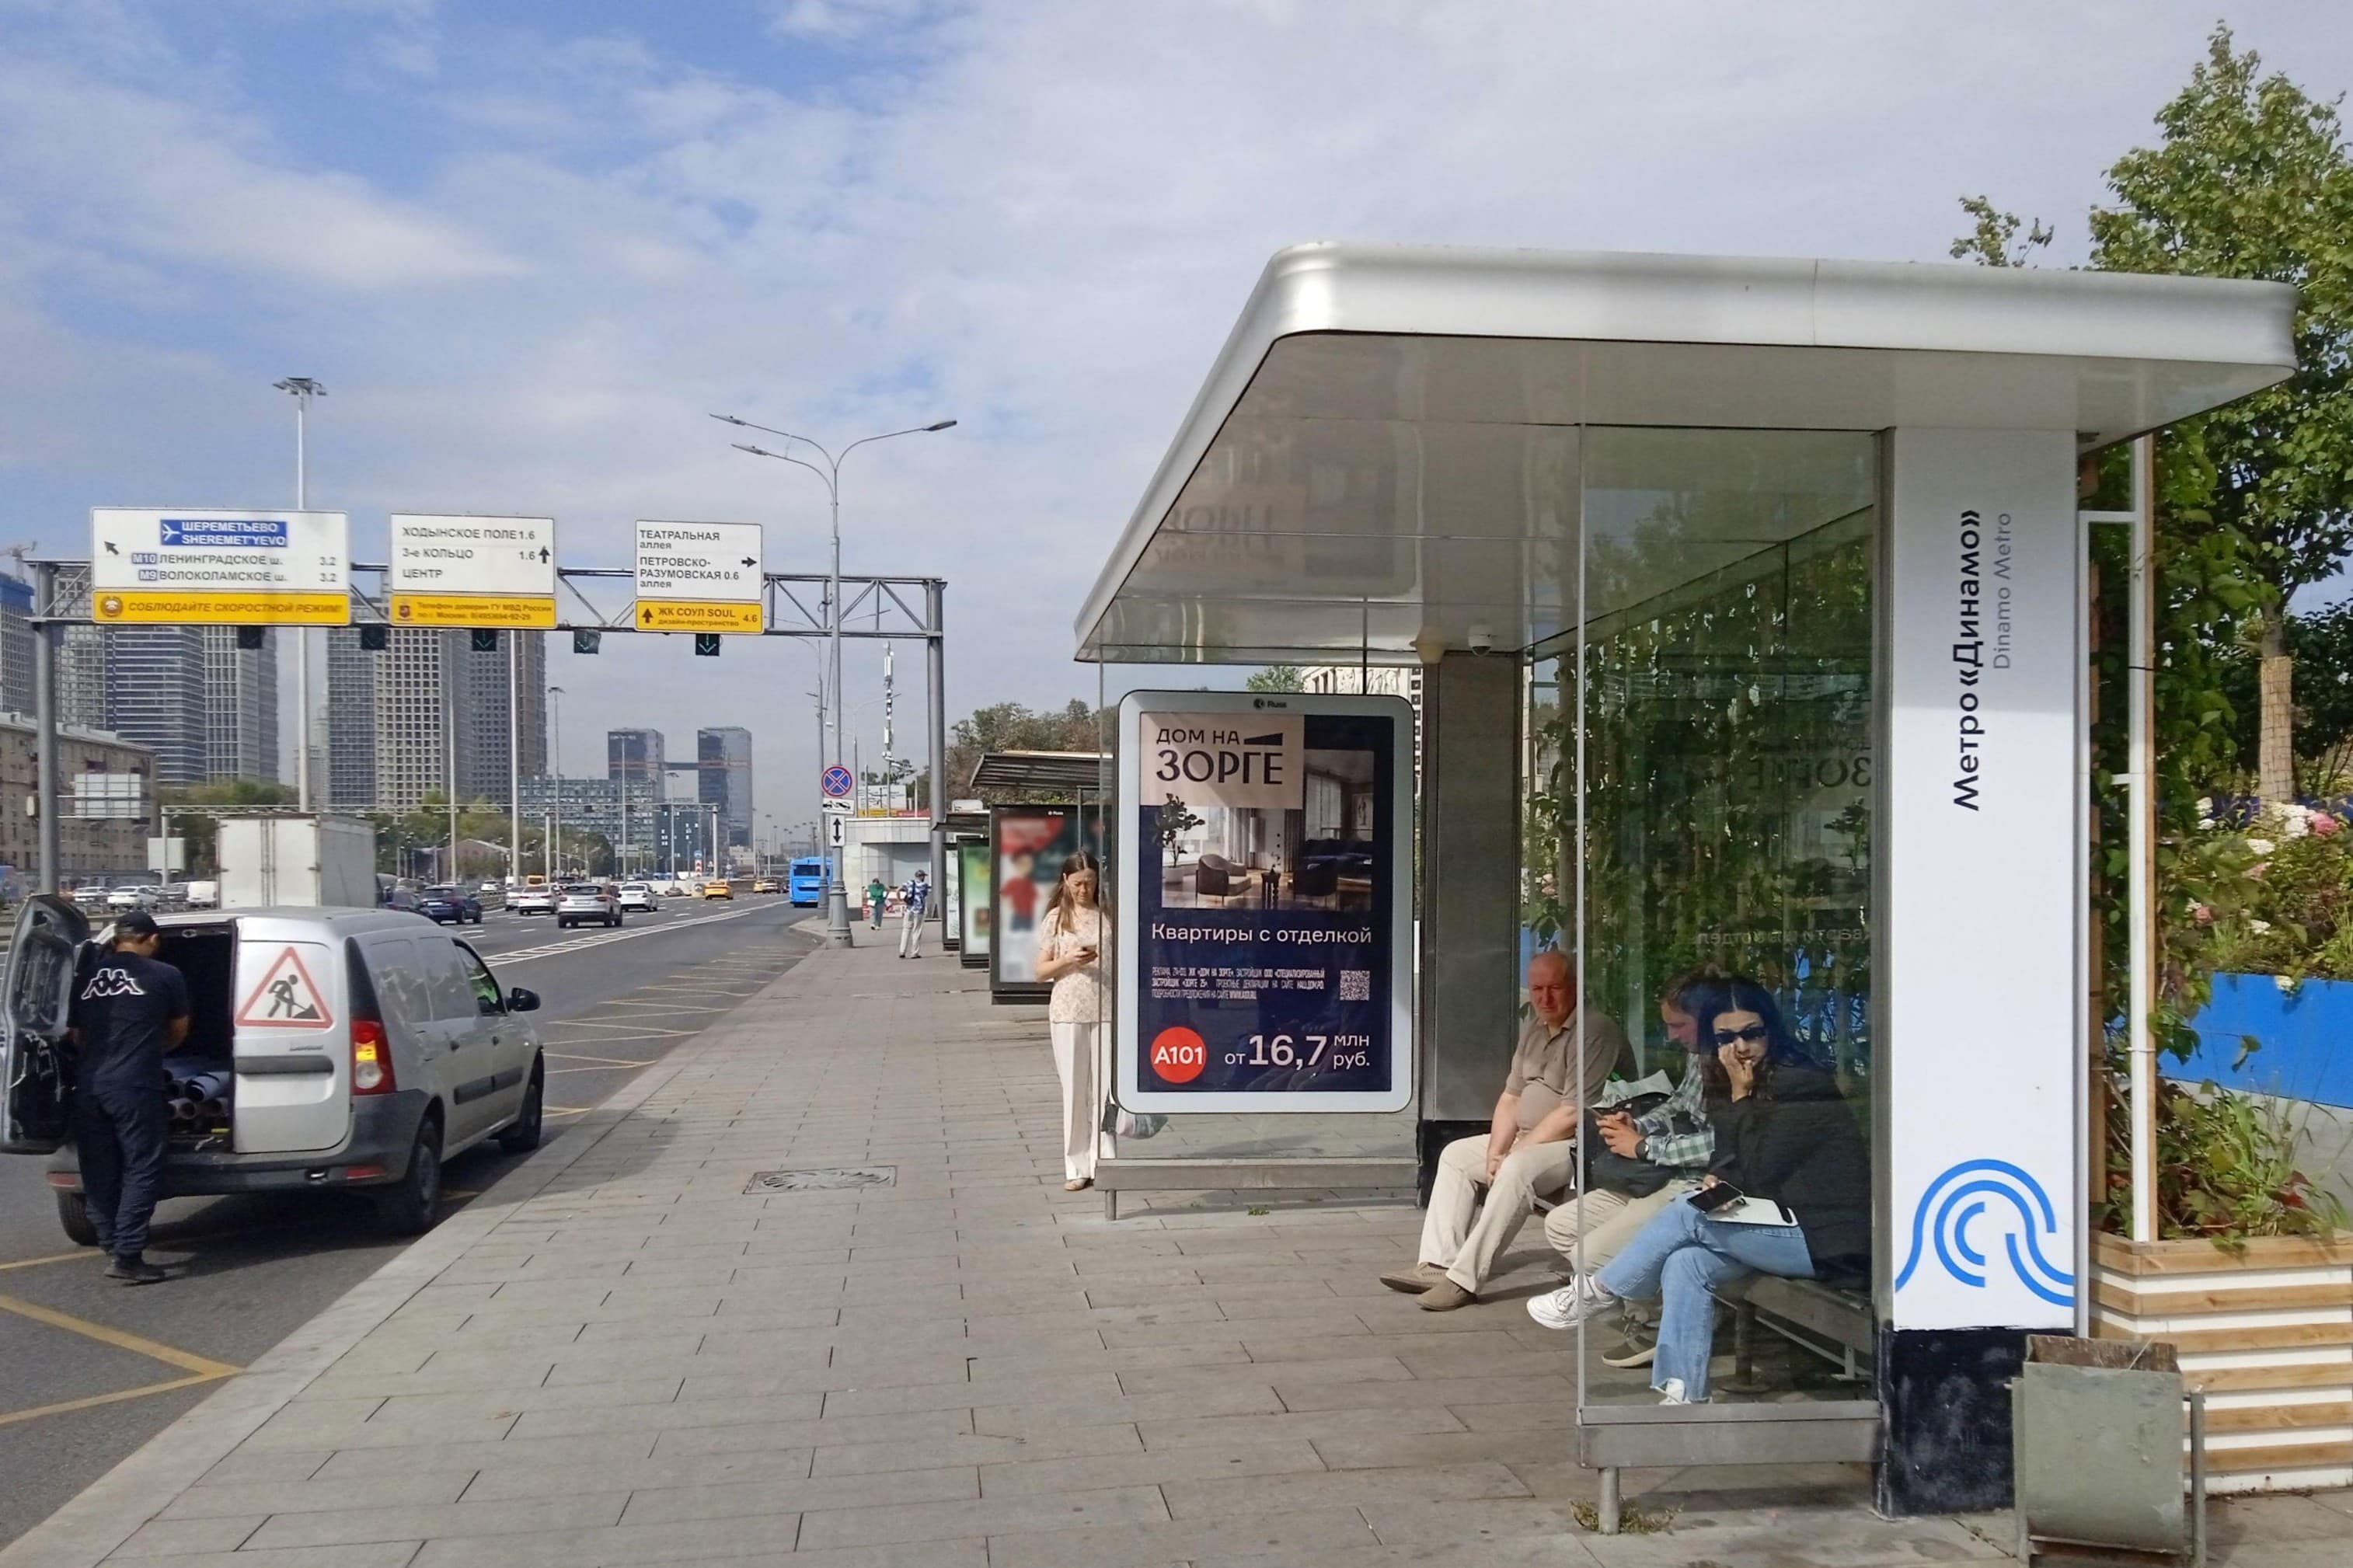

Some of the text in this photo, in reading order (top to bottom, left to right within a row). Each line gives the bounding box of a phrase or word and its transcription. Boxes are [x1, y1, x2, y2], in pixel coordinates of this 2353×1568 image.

[182, 521, 277, 532] ШЕРЕМЕТЬЕВО
[403, 528, 535, 539] ХОДЫНСКОЕ ПОЛЕ 1.6
[640, 530, 720, 540] ТЕАТРАЛЬНАЯ
[182, 535, 286, 545] SHEREMET'YEVO
[424, 549, 473, 559] КОЛЬЦО
[133, 554, 155, 564] М10
[159, 555, 265, 566] ЛЕНИНГРАДСКОЕ
[319, 557, 336, 566] 3.2
[640, 557, 711, 566] ПЕТРОВСКО-
[140, 571, 155, 580] М9
[159, 570, 270, 581] ВОЛОКОЛАМСКОЕ
[320, 573, 337, 582] 3.2
[403, 570, 443, 578] ЦЕНТР
[640, 570, 721, 580] РАЗУМОВСКАЯ
[1994, 512, 2011, 669] Dinamo Metro
[129, 601, 211, 613] СОБЛЮДАЙТЕ
[214, 603, 293, 612] СКОРОСТНОЙ
[677, 608, 704, 617] СОУЛ
[1952, 509, 1985, 811] Метро «Динамо»
[1156, 728, 1239, 745] ДОМ НА
[1156, 749, 1283, 785] ЗОРГЕ
[1152, 923, 1372, 945] Квартиры с отделкой
[1334, 1036, 1369, 1047] млн
[1225, 1035, 1328, 1071] от 16,7
[1333, 1051, 1370, 1069] руб.
